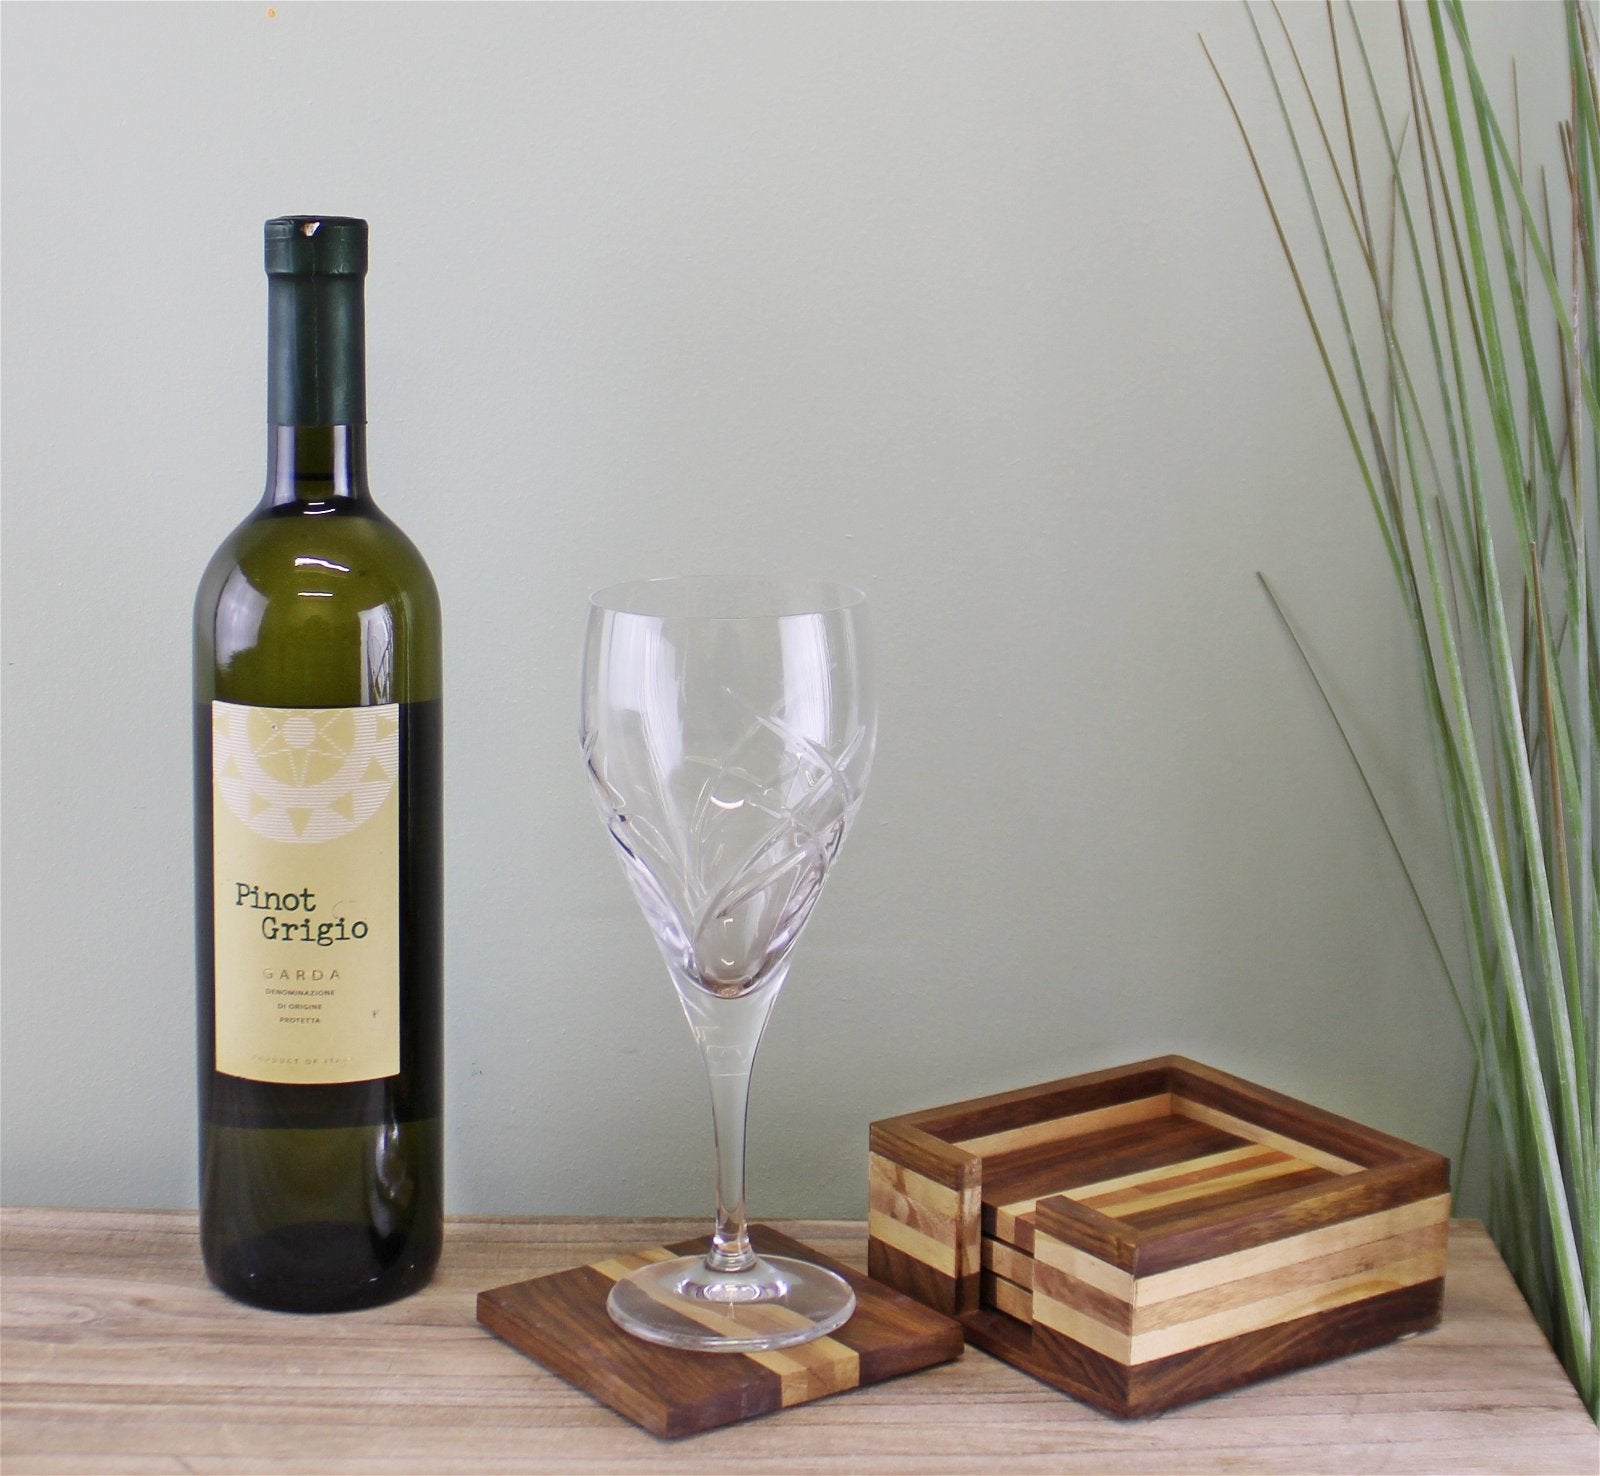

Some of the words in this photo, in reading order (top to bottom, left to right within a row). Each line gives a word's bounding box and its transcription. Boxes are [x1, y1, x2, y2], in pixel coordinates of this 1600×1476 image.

[235, 882, 316, 912] Pinot
[262, 916, 368, 947] Grigio
[262, 968, 340, 981] GARDA
[265, 988, 335, 997] DENOMINAZIONE
[277, 1002, 286, 1010] DI
[288, 1003, 322, 1011] ORIGINE
[279, 1016, 321, 1024] PROTETTA
